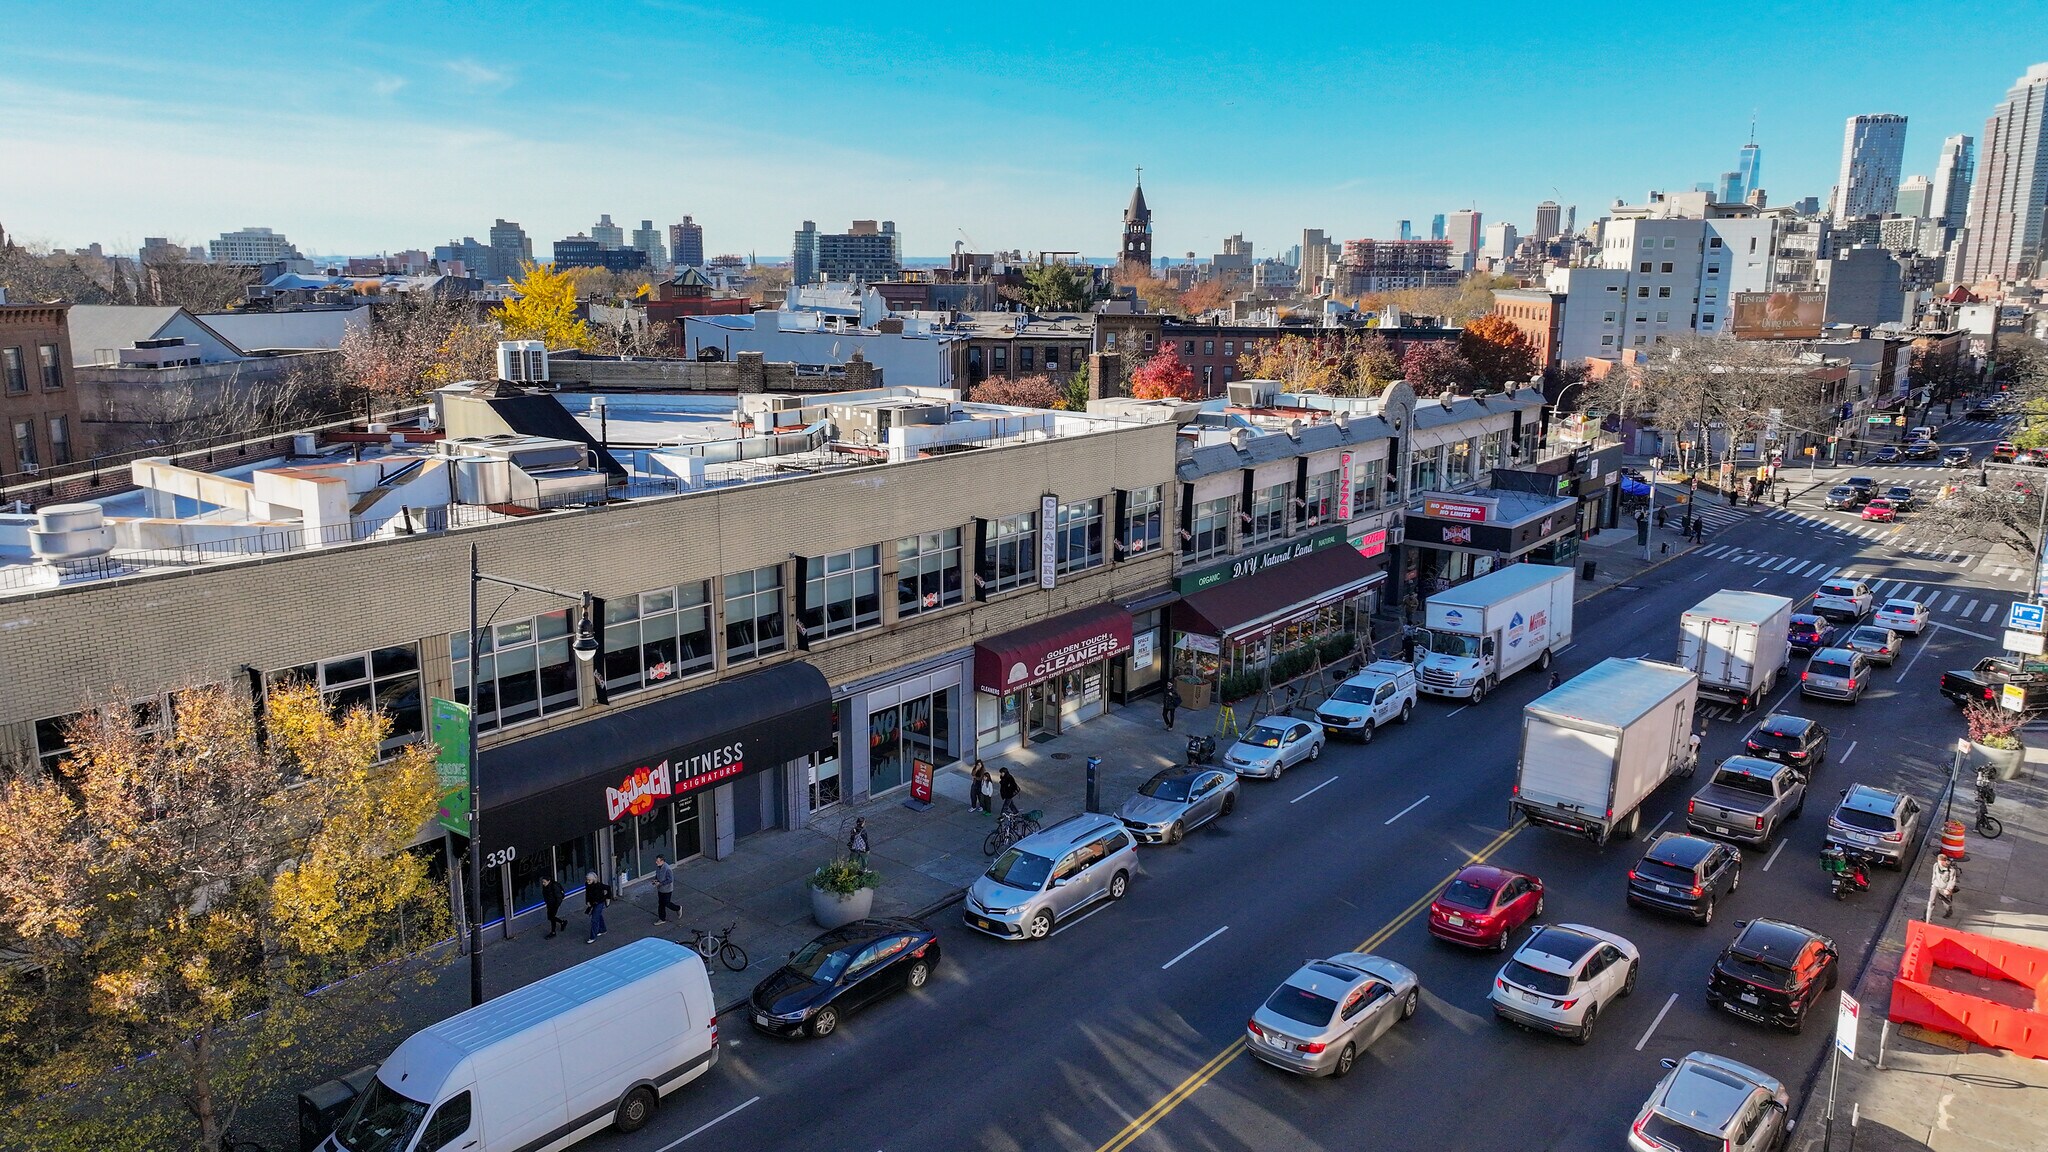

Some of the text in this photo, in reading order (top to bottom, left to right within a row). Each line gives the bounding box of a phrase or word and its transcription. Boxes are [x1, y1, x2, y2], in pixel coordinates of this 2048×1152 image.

[1339, 454, 1351, 519] PIZZA
[1441, 503, 1481, 514] JUDGMENTS,
[1043, 498, 1055, 587] CLEANERS
[1442, 526, 1471, 543] CRUNCH
[1198, 572, 1221, 586] ORGANIC
[1232, 558, 1258, 579] DNY
[1260, 546, 1292, 569] Natural
[1293, 539, 1314, 558] Land
[1033, 638, 1118, 677] CLEANERS
[1046, 632, 1108, 659] GOLDEN TOUCH
[1013, 682, 1028, 692] SHIRTS
[1028, 676, 1047, 685] LAUNDRY
[1049, 669, 1064, 679] EXPERT
[1064, 662, 1085, 673] TAILORING
[1086, 654, 1104, 665] LEATHER
[980, 685, 1000, 696] CLEANERS
[873, 710, 897, 734] NO
[606, 742, 744, 821] CRUNCH FITNESS
[683, 766, 737, 790] SIGNATURE
[487, 846, 516, 868] 330
